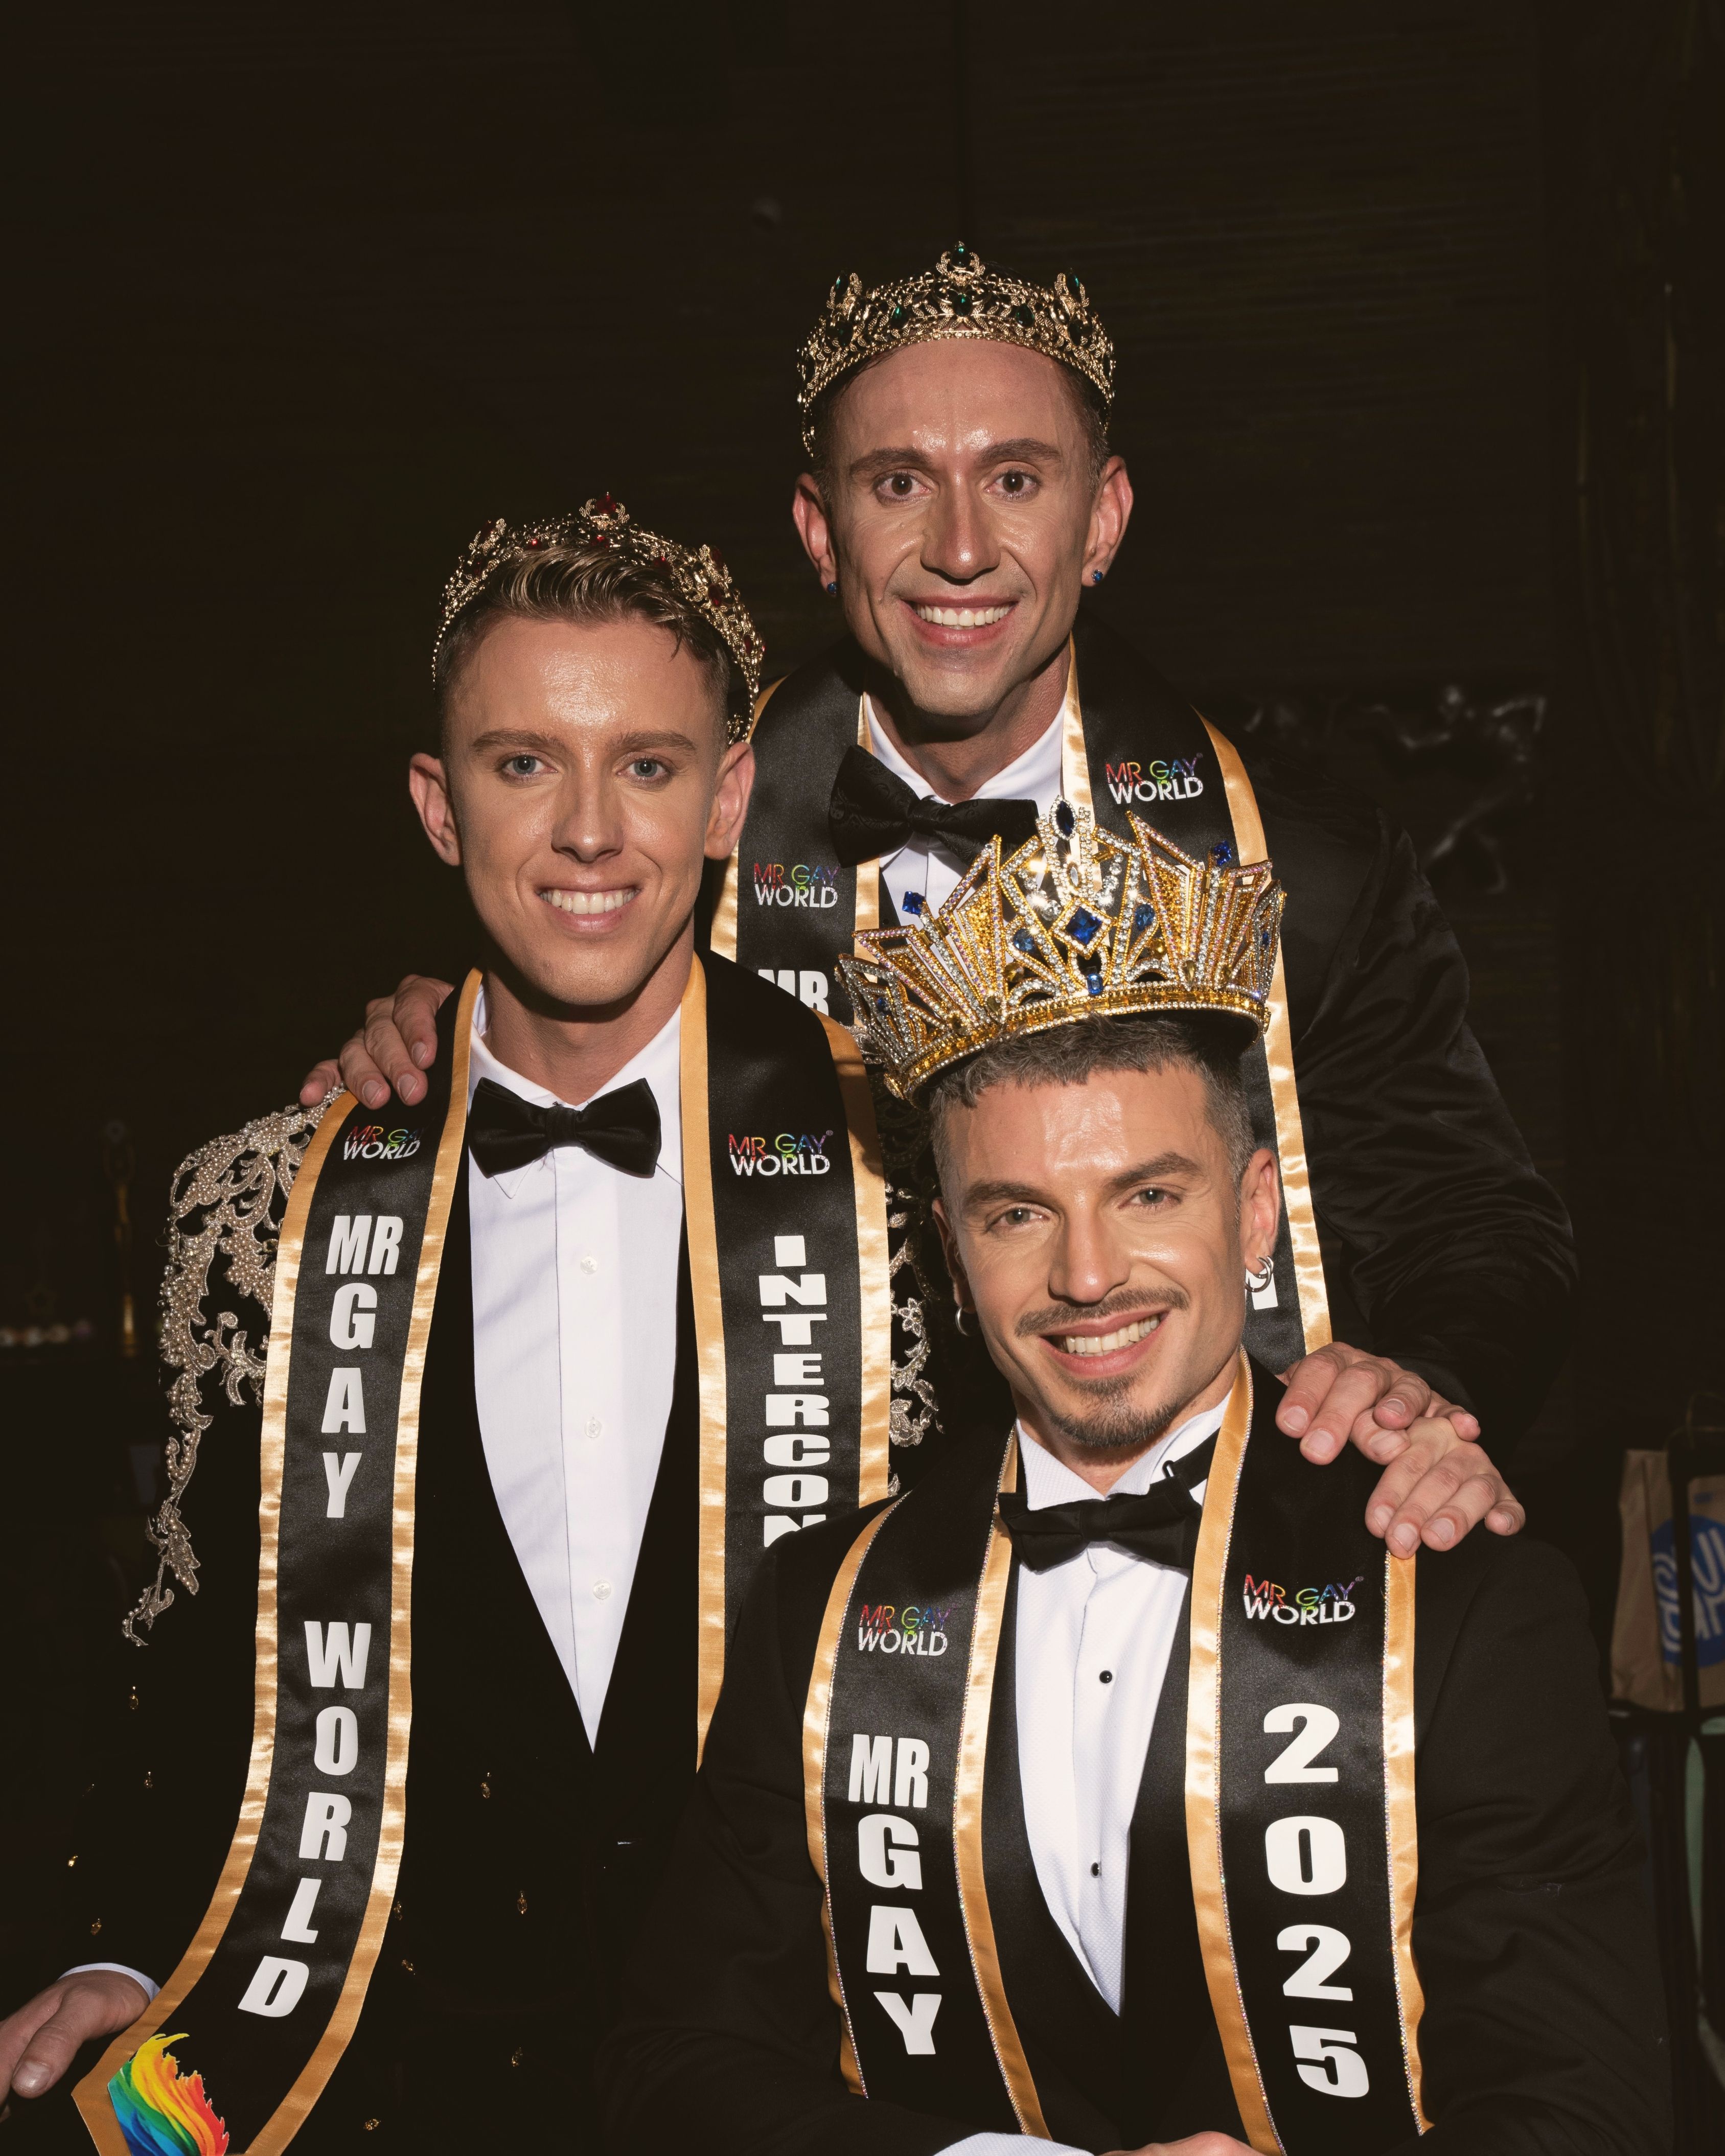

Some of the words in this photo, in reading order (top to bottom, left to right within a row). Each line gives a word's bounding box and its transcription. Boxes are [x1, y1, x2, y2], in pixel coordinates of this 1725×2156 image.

[1105, 761, 1144, 784] MR
[1149, 757, 1198, 780] GAY
[1108, 776, 1203, 804] WORLD
[753, 863, 785, 885] MR
[791, 864, 840, 886] GAY
[754, 883, 838, 909] WORLD
[347, 1125, 383, 1142] MR
[728, 1133, 767, 1156] MR
[774, 1133, 827, 1155] GAY
[343, 1140, 421, 1161] WORLD
[729, 1152, 831, 1176] WORLD
[325, 1215, 404, 1275] MR
[321, 1282, 378, 1518] GAY
[1244, 1574, 1286, 1605] MR
[1295, 1581, 1355, 1606] GAY
[859, 1604, 895, 1628] MR
[901, 1606, 953, 1631] GAY
[1243, 1595, 1355, 1626] WORLD
[858, 1626, 948, 1656] WORLD
[848, 1733, 930, 1809] MR
[238, 1620, 372, 2018] WORLD
[1263, 1703, 1369, 2098] 2025
[858, 1814, 941, 2055] GAY
